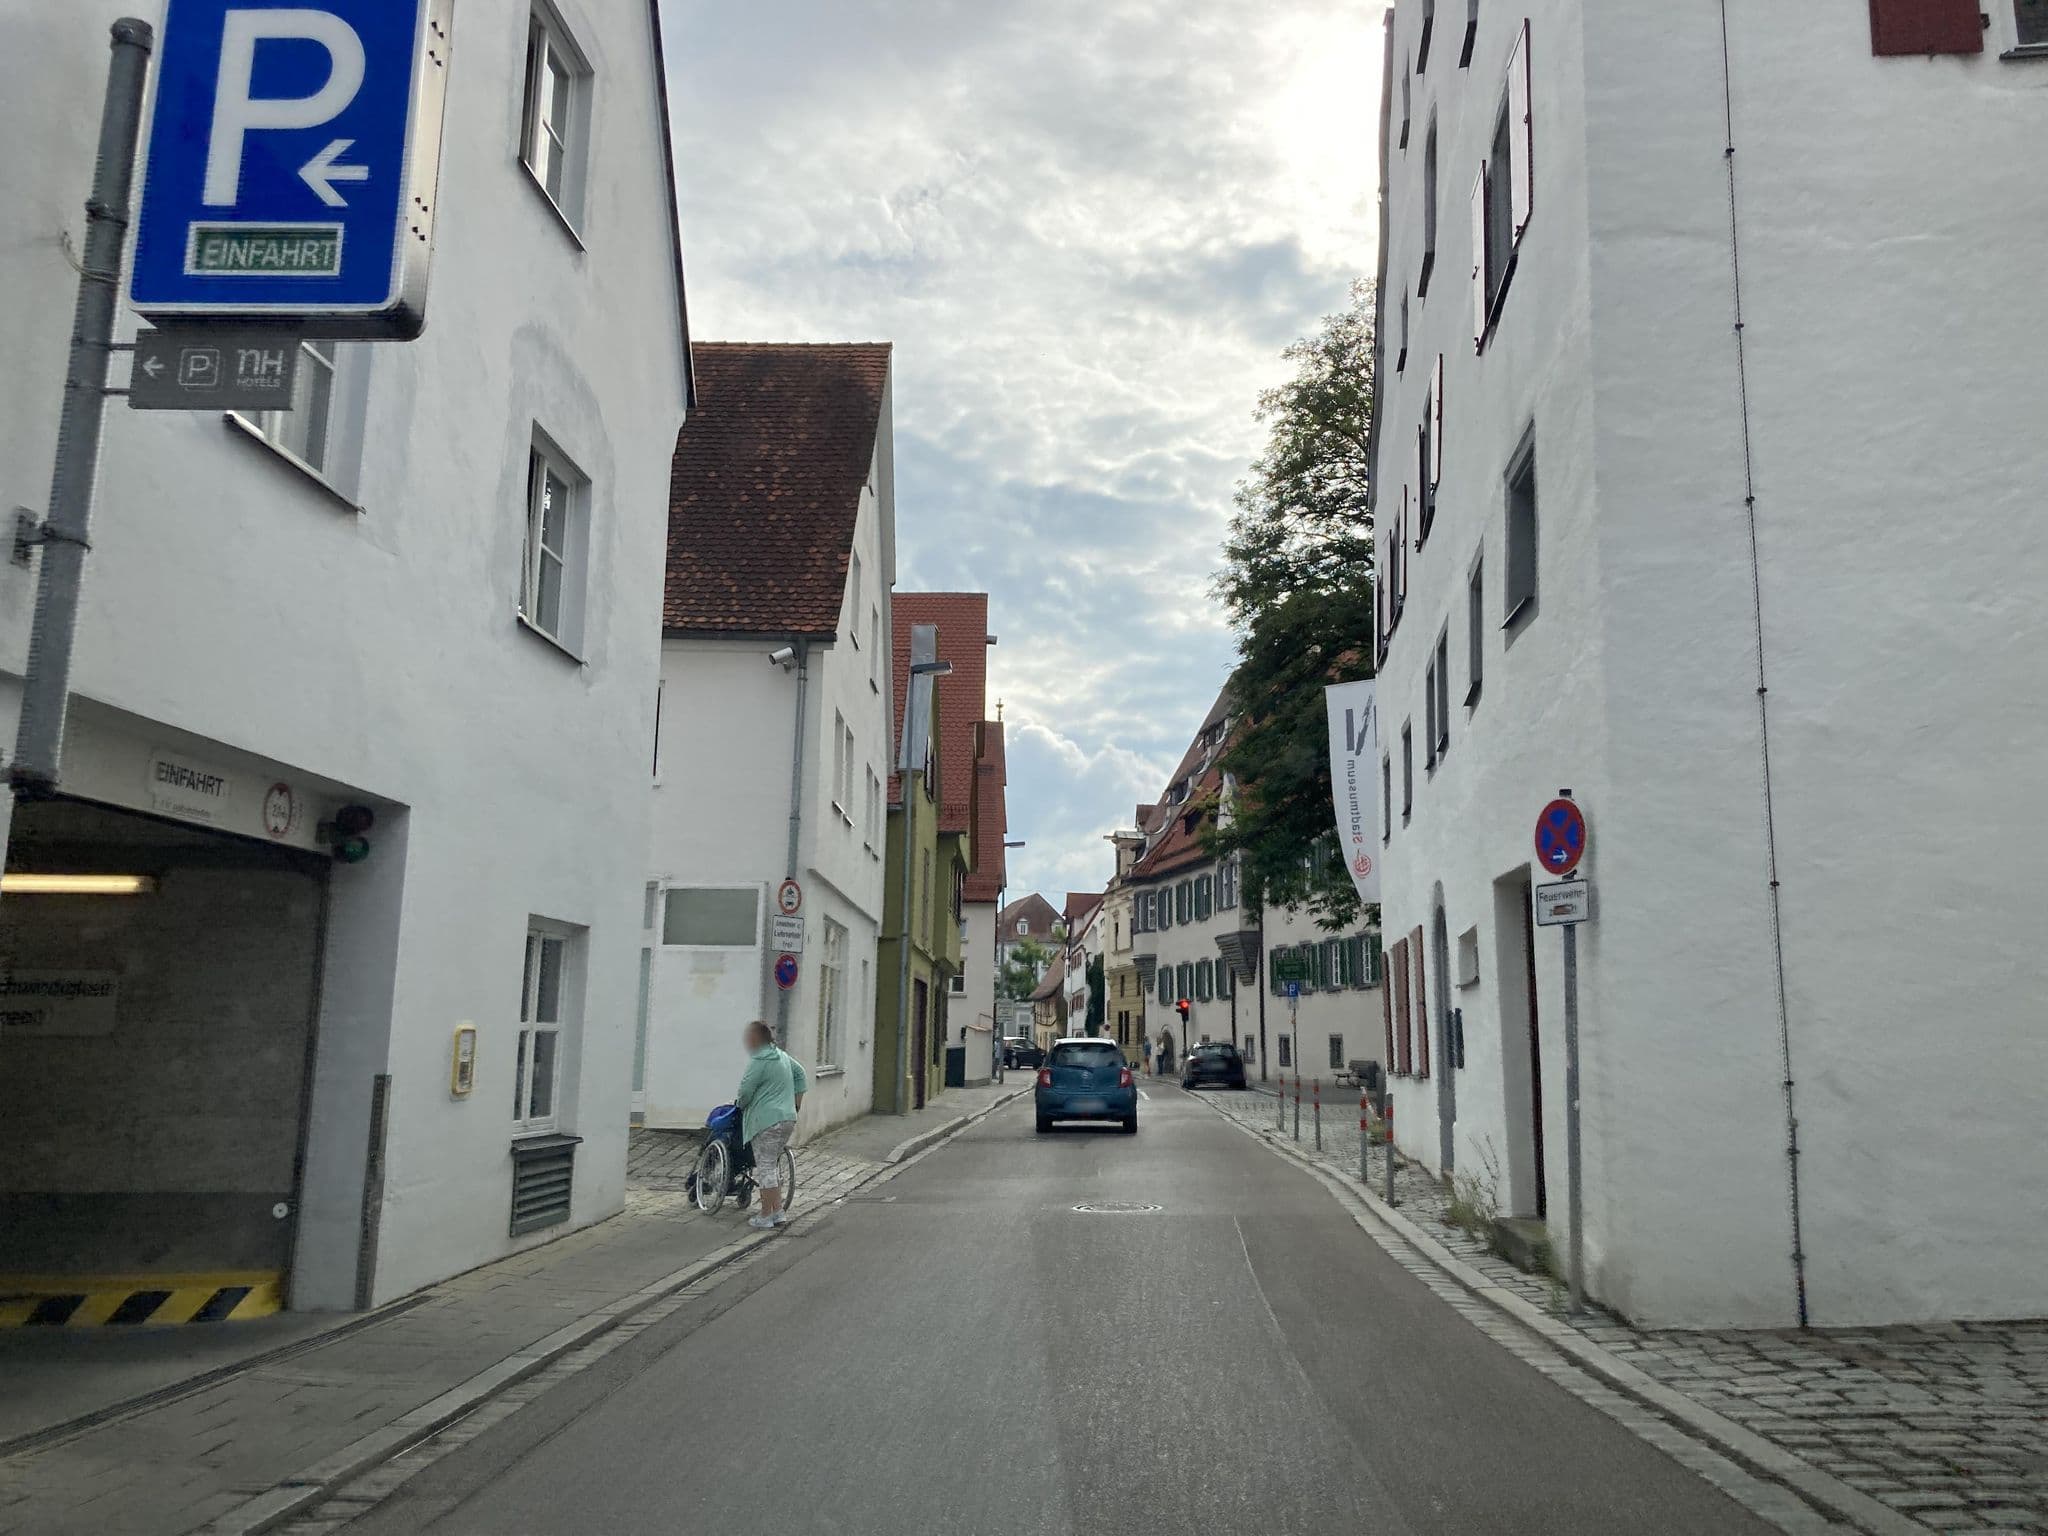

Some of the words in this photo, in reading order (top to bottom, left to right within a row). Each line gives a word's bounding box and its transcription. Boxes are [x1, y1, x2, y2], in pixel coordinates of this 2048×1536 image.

[203, 8, 366, 207] P
[203, 239, 337, 267] EINFAHRT
[188, 355, 210, 378] P
[237, 377, 281, 388] HOTELS
[156, 761, 225, 797] EINFAHRT
